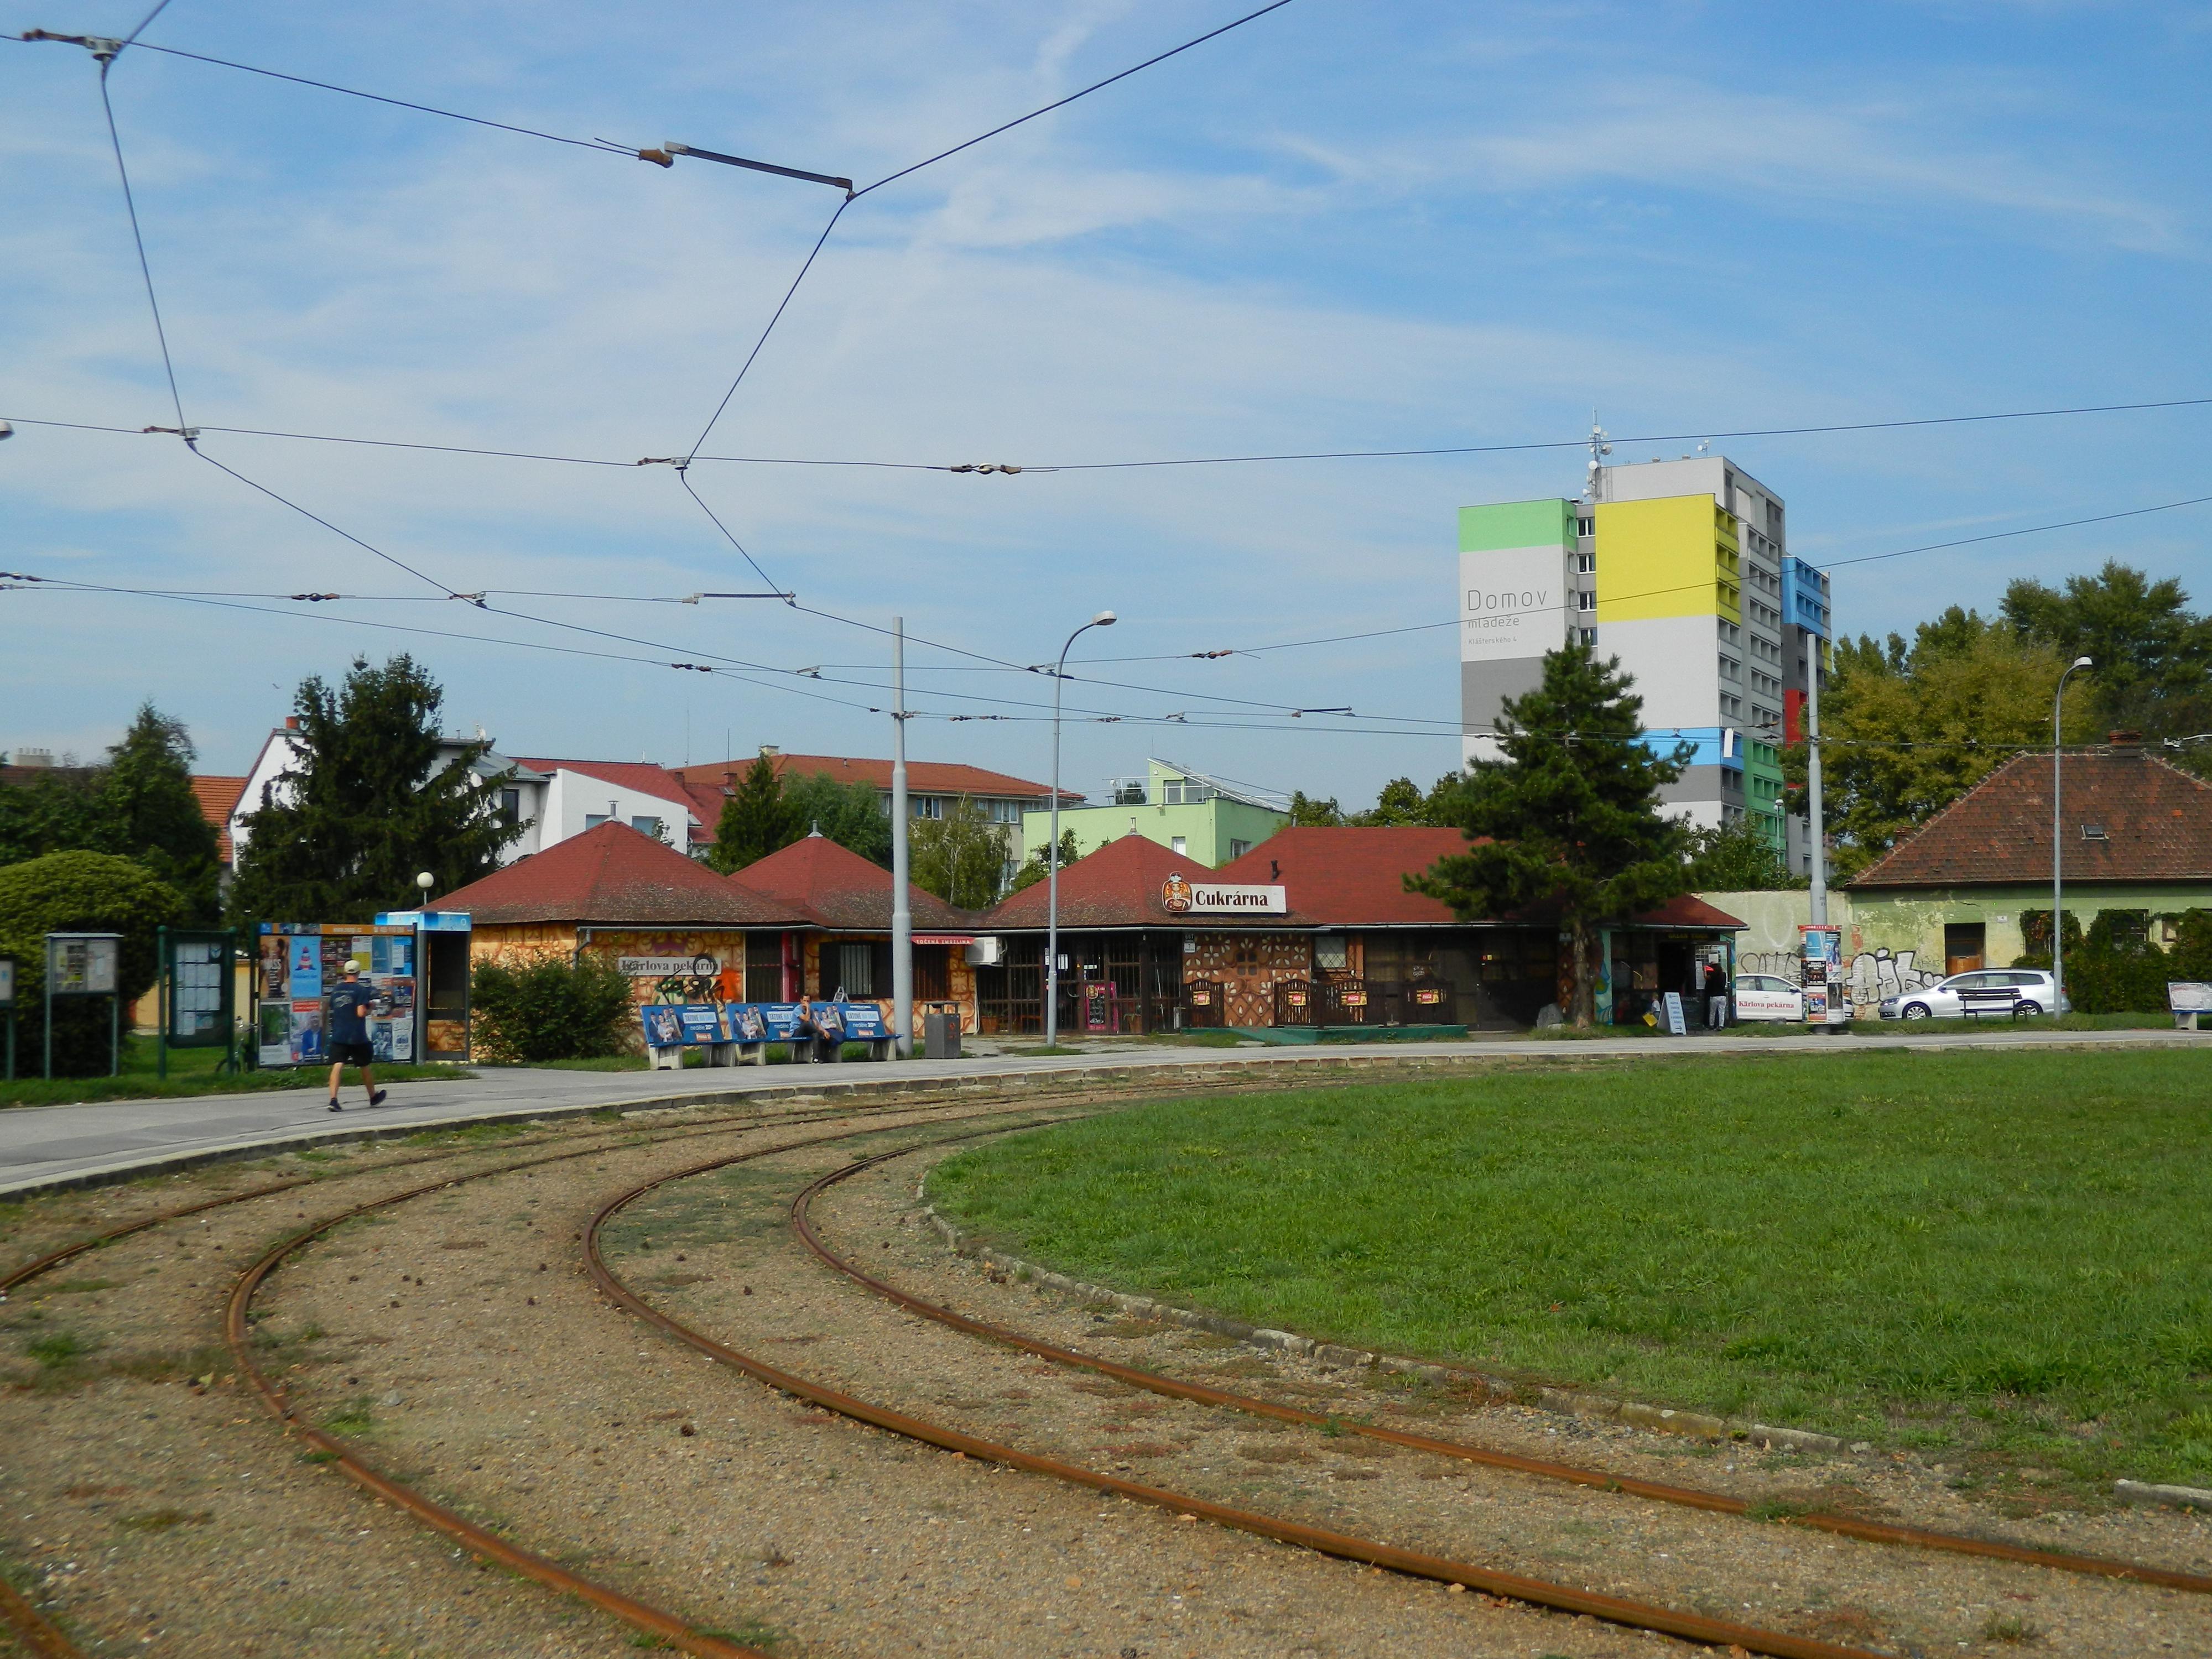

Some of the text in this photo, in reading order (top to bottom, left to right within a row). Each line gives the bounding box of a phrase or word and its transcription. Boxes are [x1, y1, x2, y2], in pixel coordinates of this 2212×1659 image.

[1467, 589, 1547, 611] Domov
[1468, 637, 1511, 645] Klášterského
[1195, 890, 1268, 906] Cukrárna
